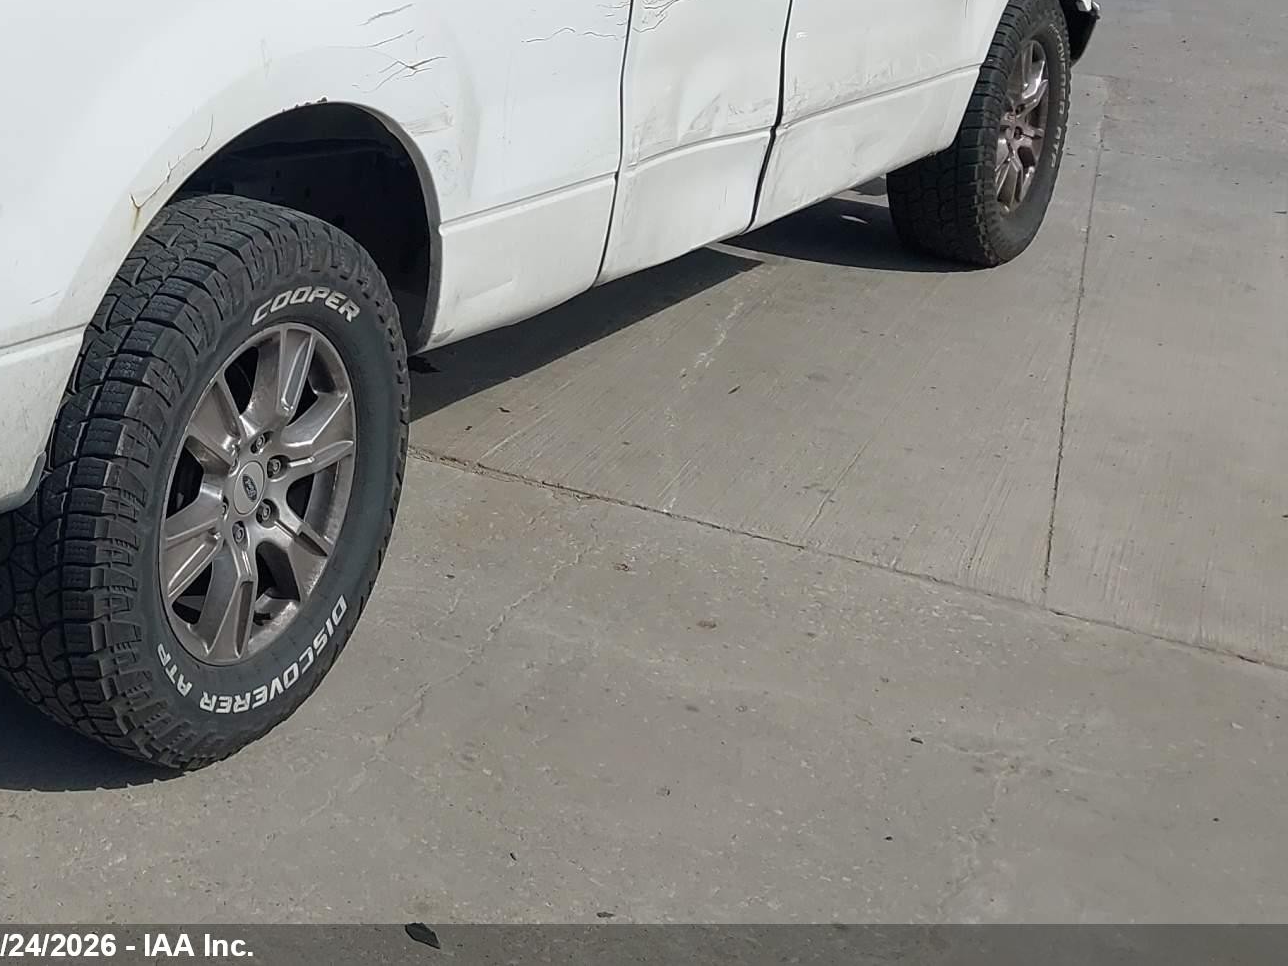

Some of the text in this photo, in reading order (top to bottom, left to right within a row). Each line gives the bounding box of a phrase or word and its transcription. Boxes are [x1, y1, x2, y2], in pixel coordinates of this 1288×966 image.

[252, 286, 361, 323] COOPER
[157, 595, 348, 714] DISCOVERER ATP
